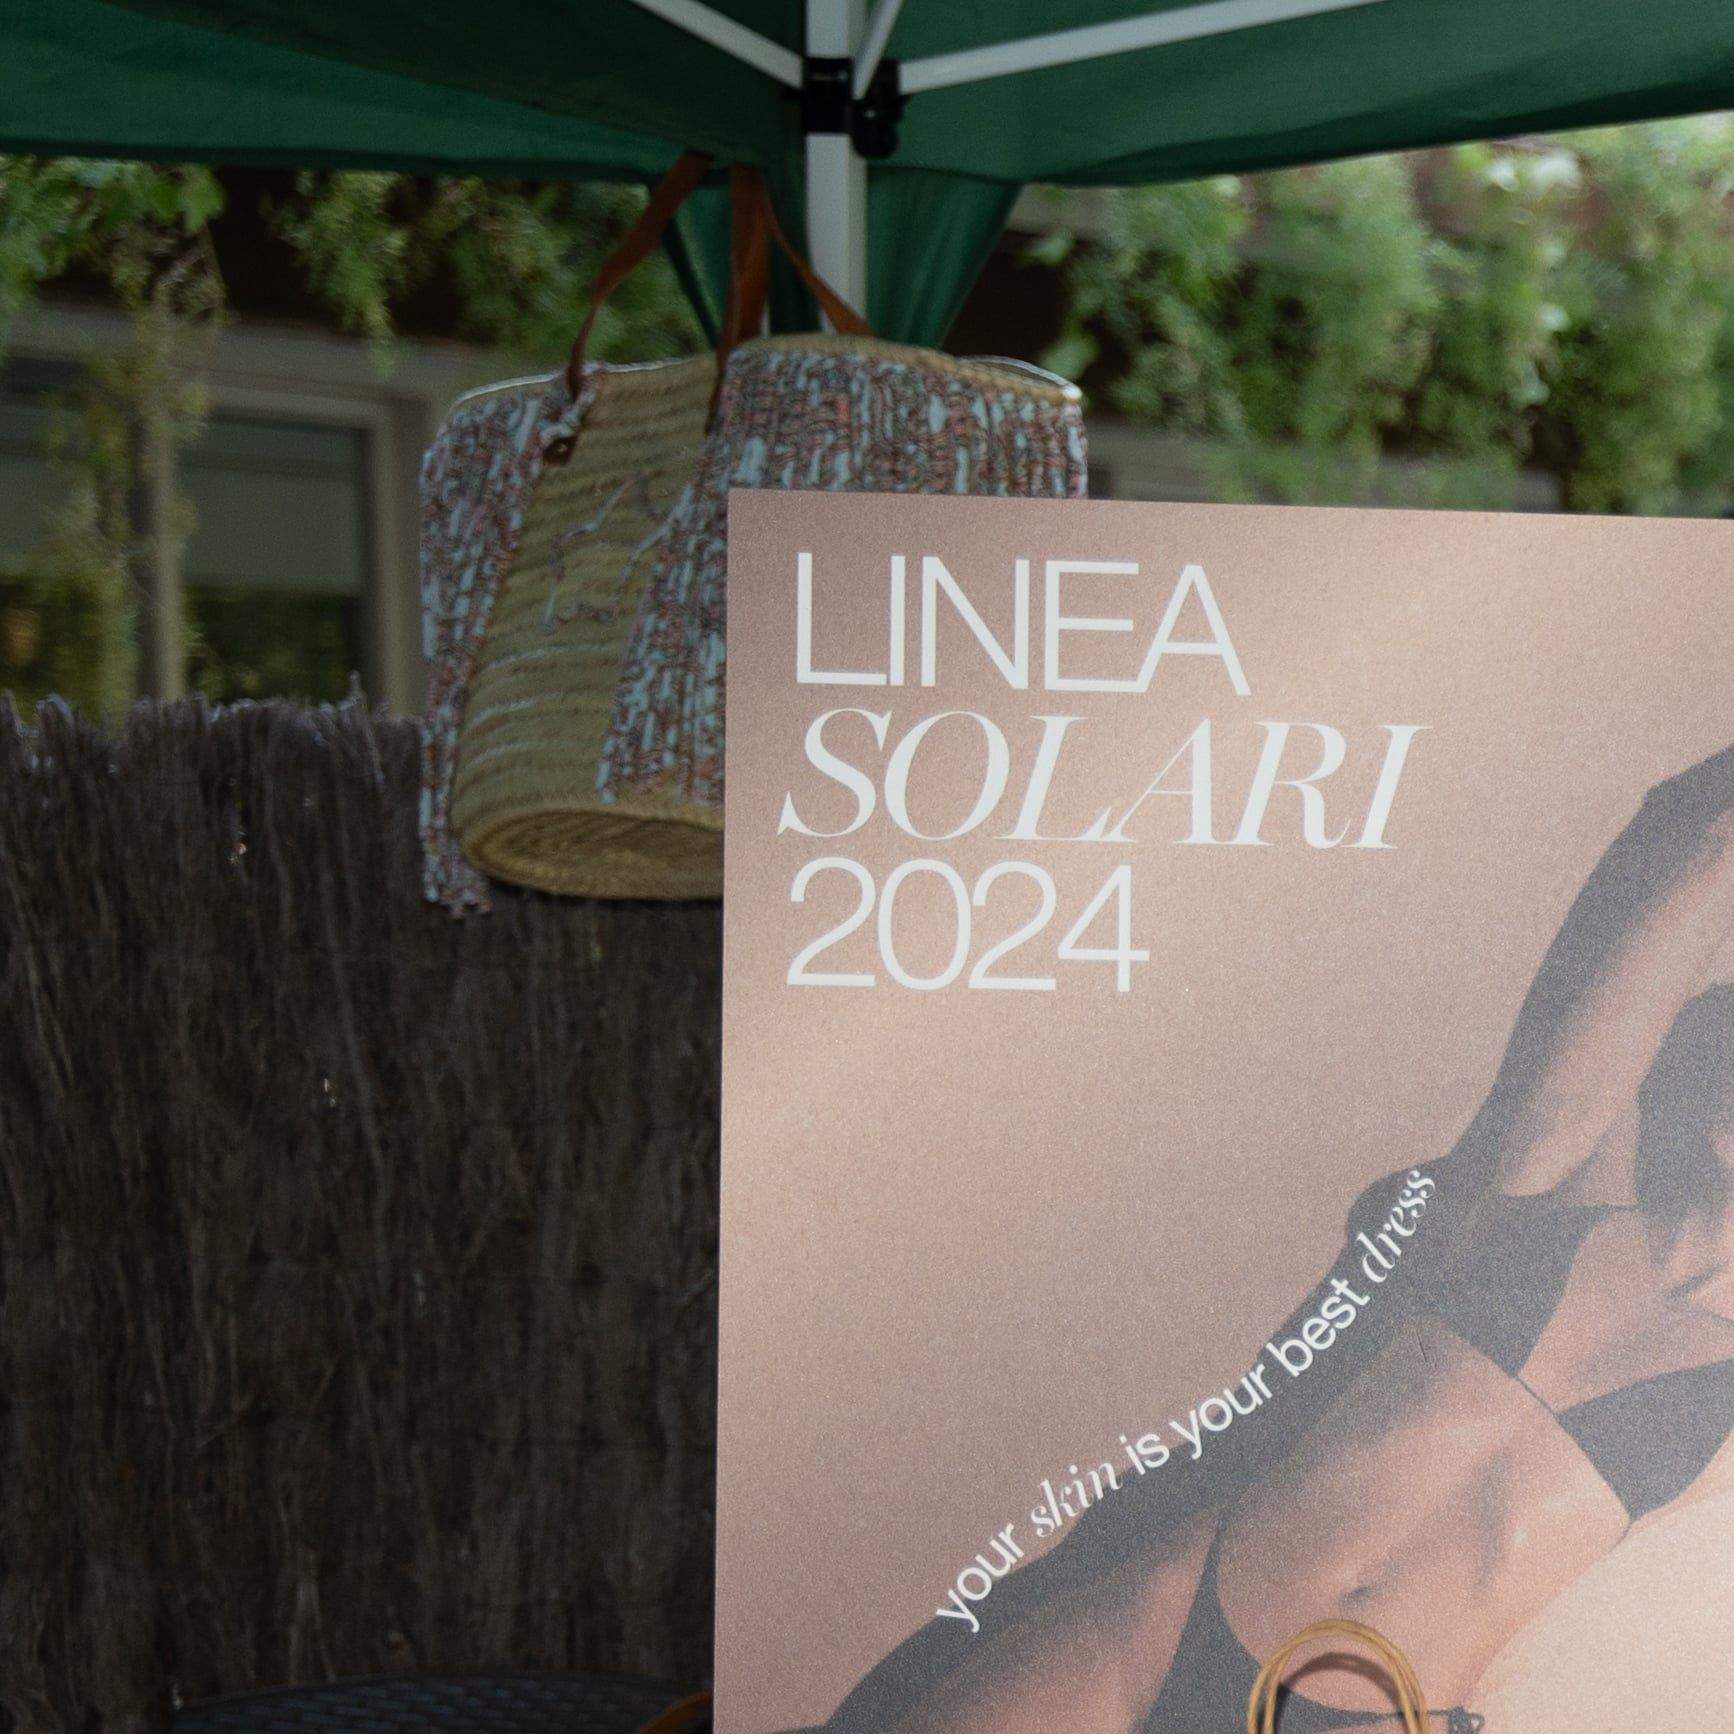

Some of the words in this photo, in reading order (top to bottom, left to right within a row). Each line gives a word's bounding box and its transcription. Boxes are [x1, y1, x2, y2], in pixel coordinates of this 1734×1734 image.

[797, 552, 1251, 697] LINEA
[776, 708, 1433, 850] SOLARI
[786, 857, 1150, 992] 2024
[935, 1522, 1026, 1633] your
[1029, 1457, 1124, 1538] skin
[1119, 1431, 1171, 1475] is
[1169, 1363, 1274, 1459] your
[1265, 1277, 1371, 1378] best
[1355, 1169, 1437, 1285] dress
